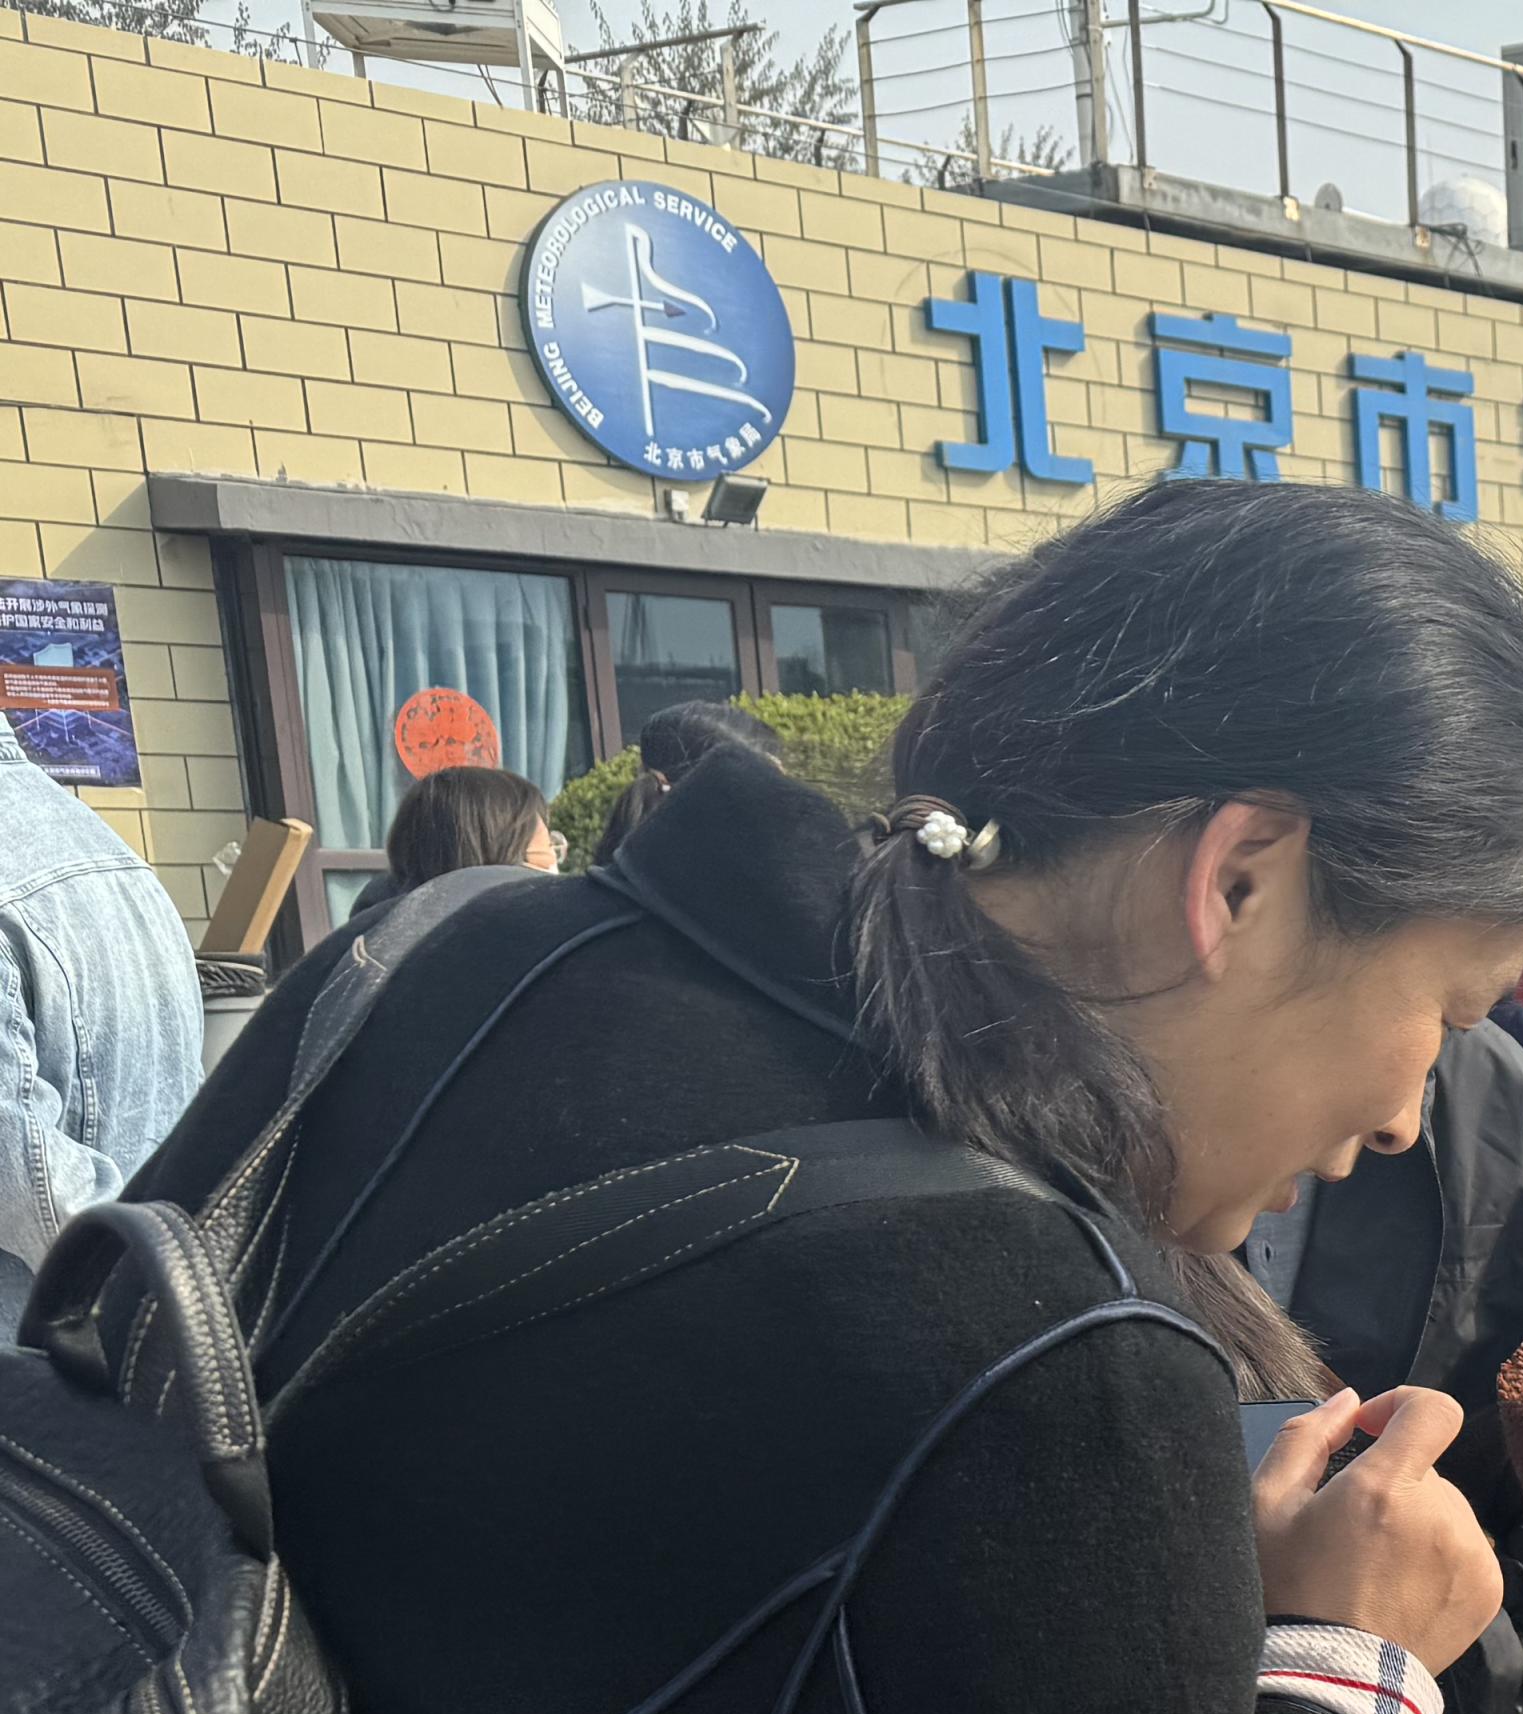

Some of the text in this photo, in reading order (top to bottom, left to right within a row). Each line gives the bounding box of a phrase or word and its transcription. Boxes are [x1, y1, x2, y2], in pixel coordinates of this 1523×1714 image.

[535, 186, 739, 430] BEIJING METEOROLOGICAL SERVICE
[643, 421, 762, 470] 北京市气象局
[0, 613, 104, 632] 护国家安全和利益
